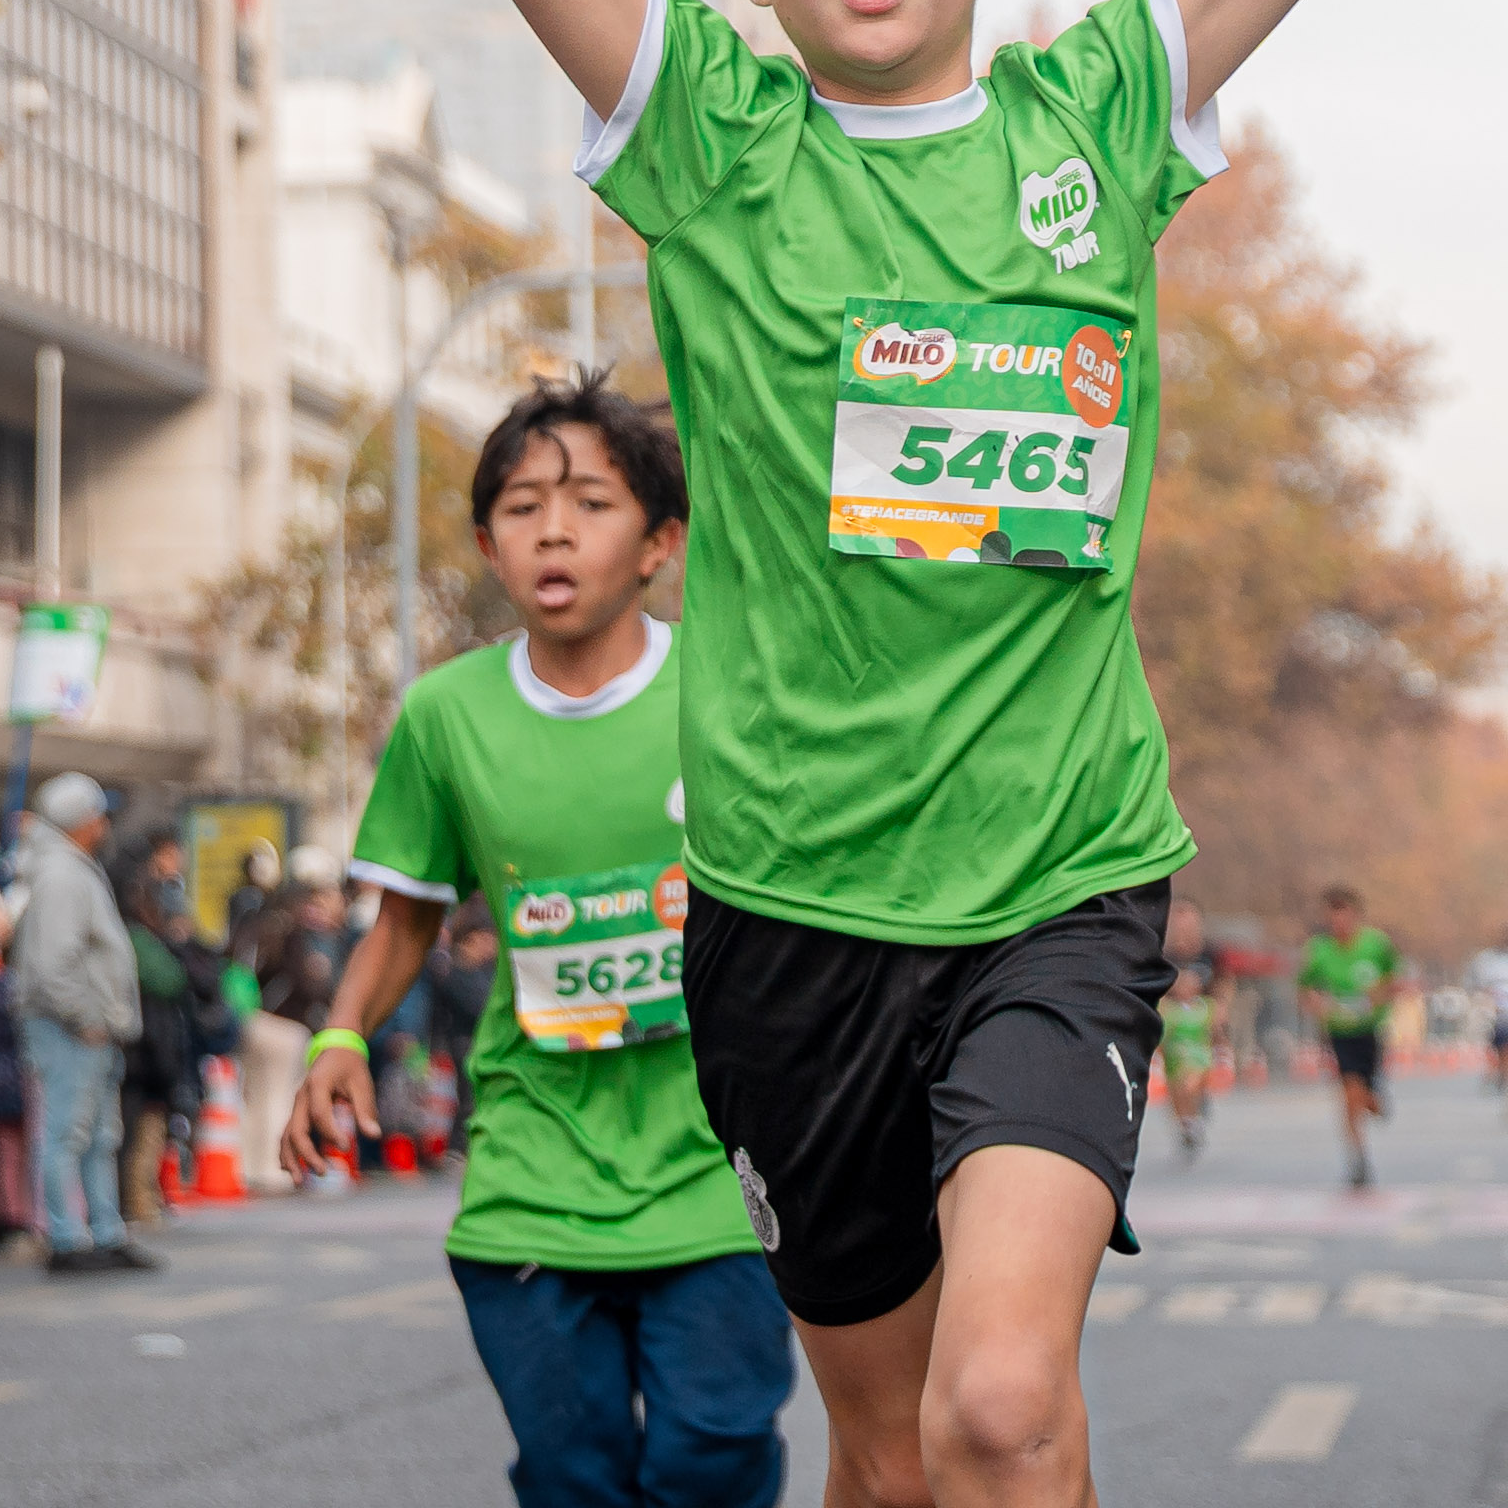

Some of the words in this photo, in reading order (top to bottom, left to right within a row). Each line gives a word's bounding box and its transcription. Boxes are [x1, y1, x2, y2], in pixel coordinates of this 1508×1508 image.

[1029, 182, 1088, 232] MILO
[1050, 230, 1101, 274] TOUR
[870, 338, 946, 366] MILO
[969, 343, 1063, 377] TOUR
[1076, 342, 1096, 372] 10
[1071, 374, 1112, 409] AÑOS
[891, 425, 1097, 495] 5465
[841, 503, 987, 526] #TEHACEGRANDE
[577, 889, 648, 922] TOUR
[555, 943, 684, 996] 5628
